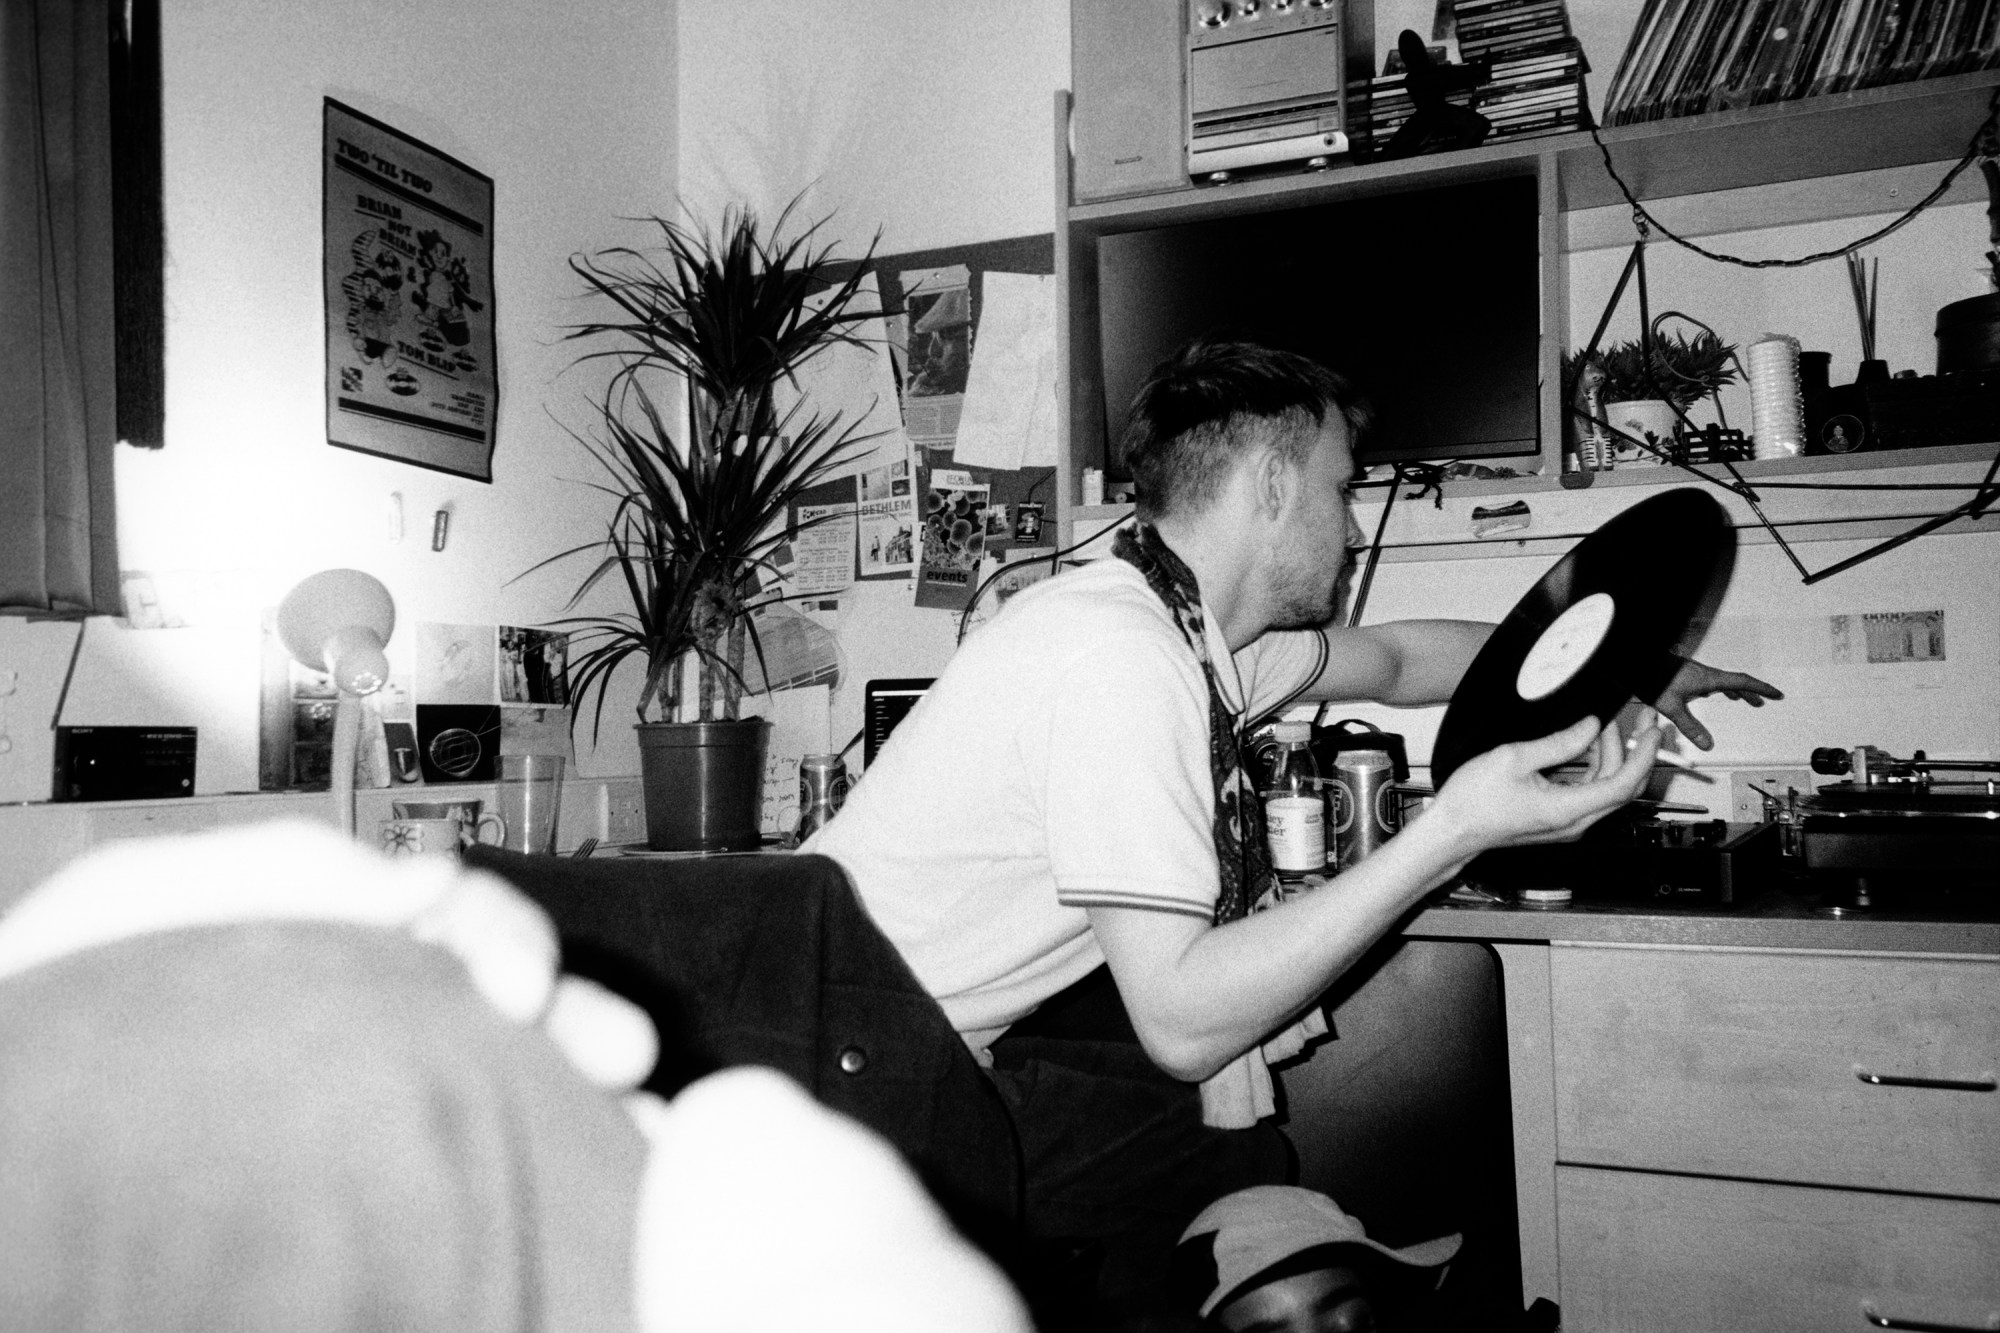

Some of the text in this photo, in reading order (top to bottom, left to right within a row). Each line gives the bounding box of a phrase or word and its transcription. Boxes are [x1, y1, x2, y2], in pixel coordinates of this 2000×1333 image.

[337, 138, 369, 164] TWO
[402, 169, 432, 193] TWO
[357, 194, 402, 219] BRIAN
[387, 220, 412, 237] NOT
[379, 228, 417, 255] BRIAN
[397, 341, 457, 373] TOM BLIP
[862, 500, 911, 515] BETHLEM
[926, 571, 968, 583] events
